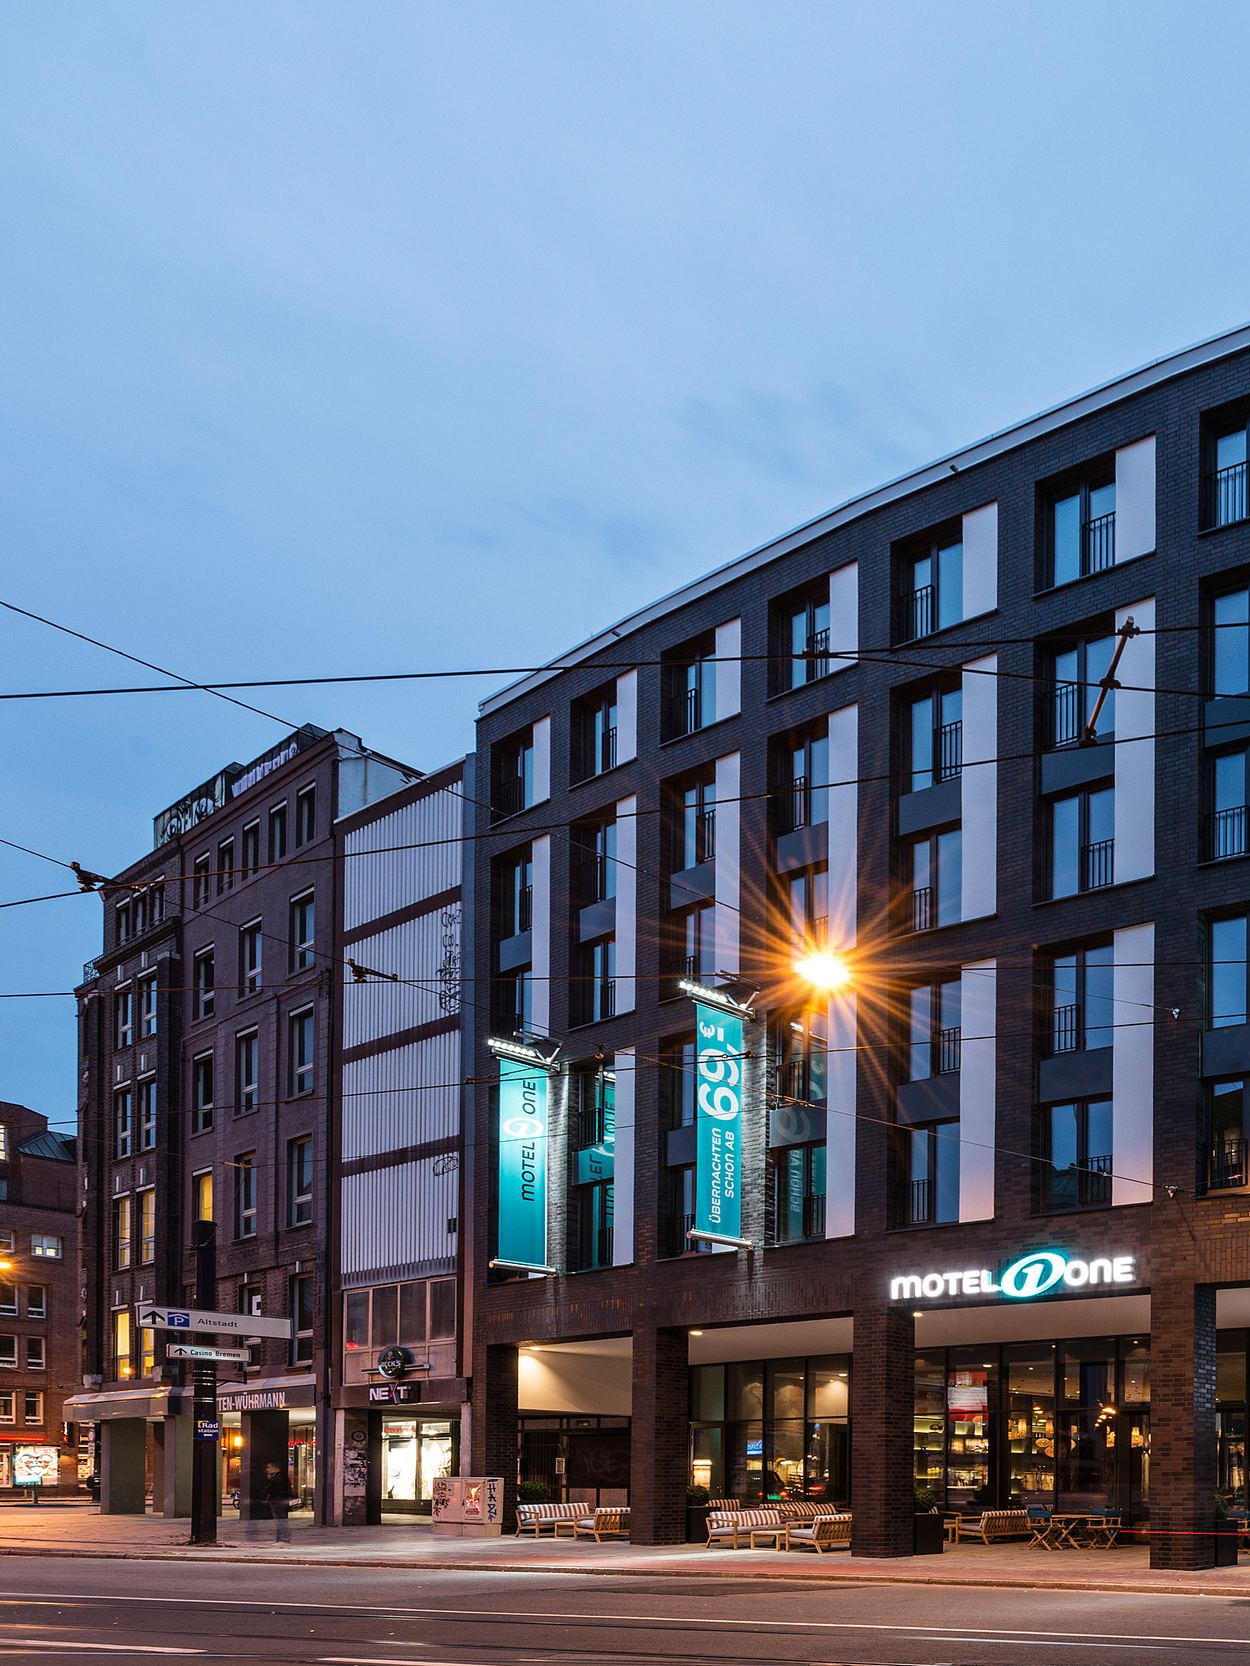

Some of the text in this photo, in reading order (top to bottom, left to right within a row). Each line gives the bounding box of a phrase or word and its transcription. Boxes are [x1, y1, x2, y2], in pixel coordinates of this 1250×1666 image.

[522, 1079, 537, 1115] ONE
[521, 1142, 535, 1201] MOTEL
[708, 1128, 722, 1224] ÜBERNACHTEN
[725, 1131, 735, 1199] SCHON AB
[890, 1269, 1002, 1299] MOTEL
[1063, 1256, 1134, 1286] ONE
[197, 1318, 238, 1328] Altstadt
[216, 1391, 286, 1411] TEN-WÜHRMANN
[369, 1381, 407, 1404] NEXT
